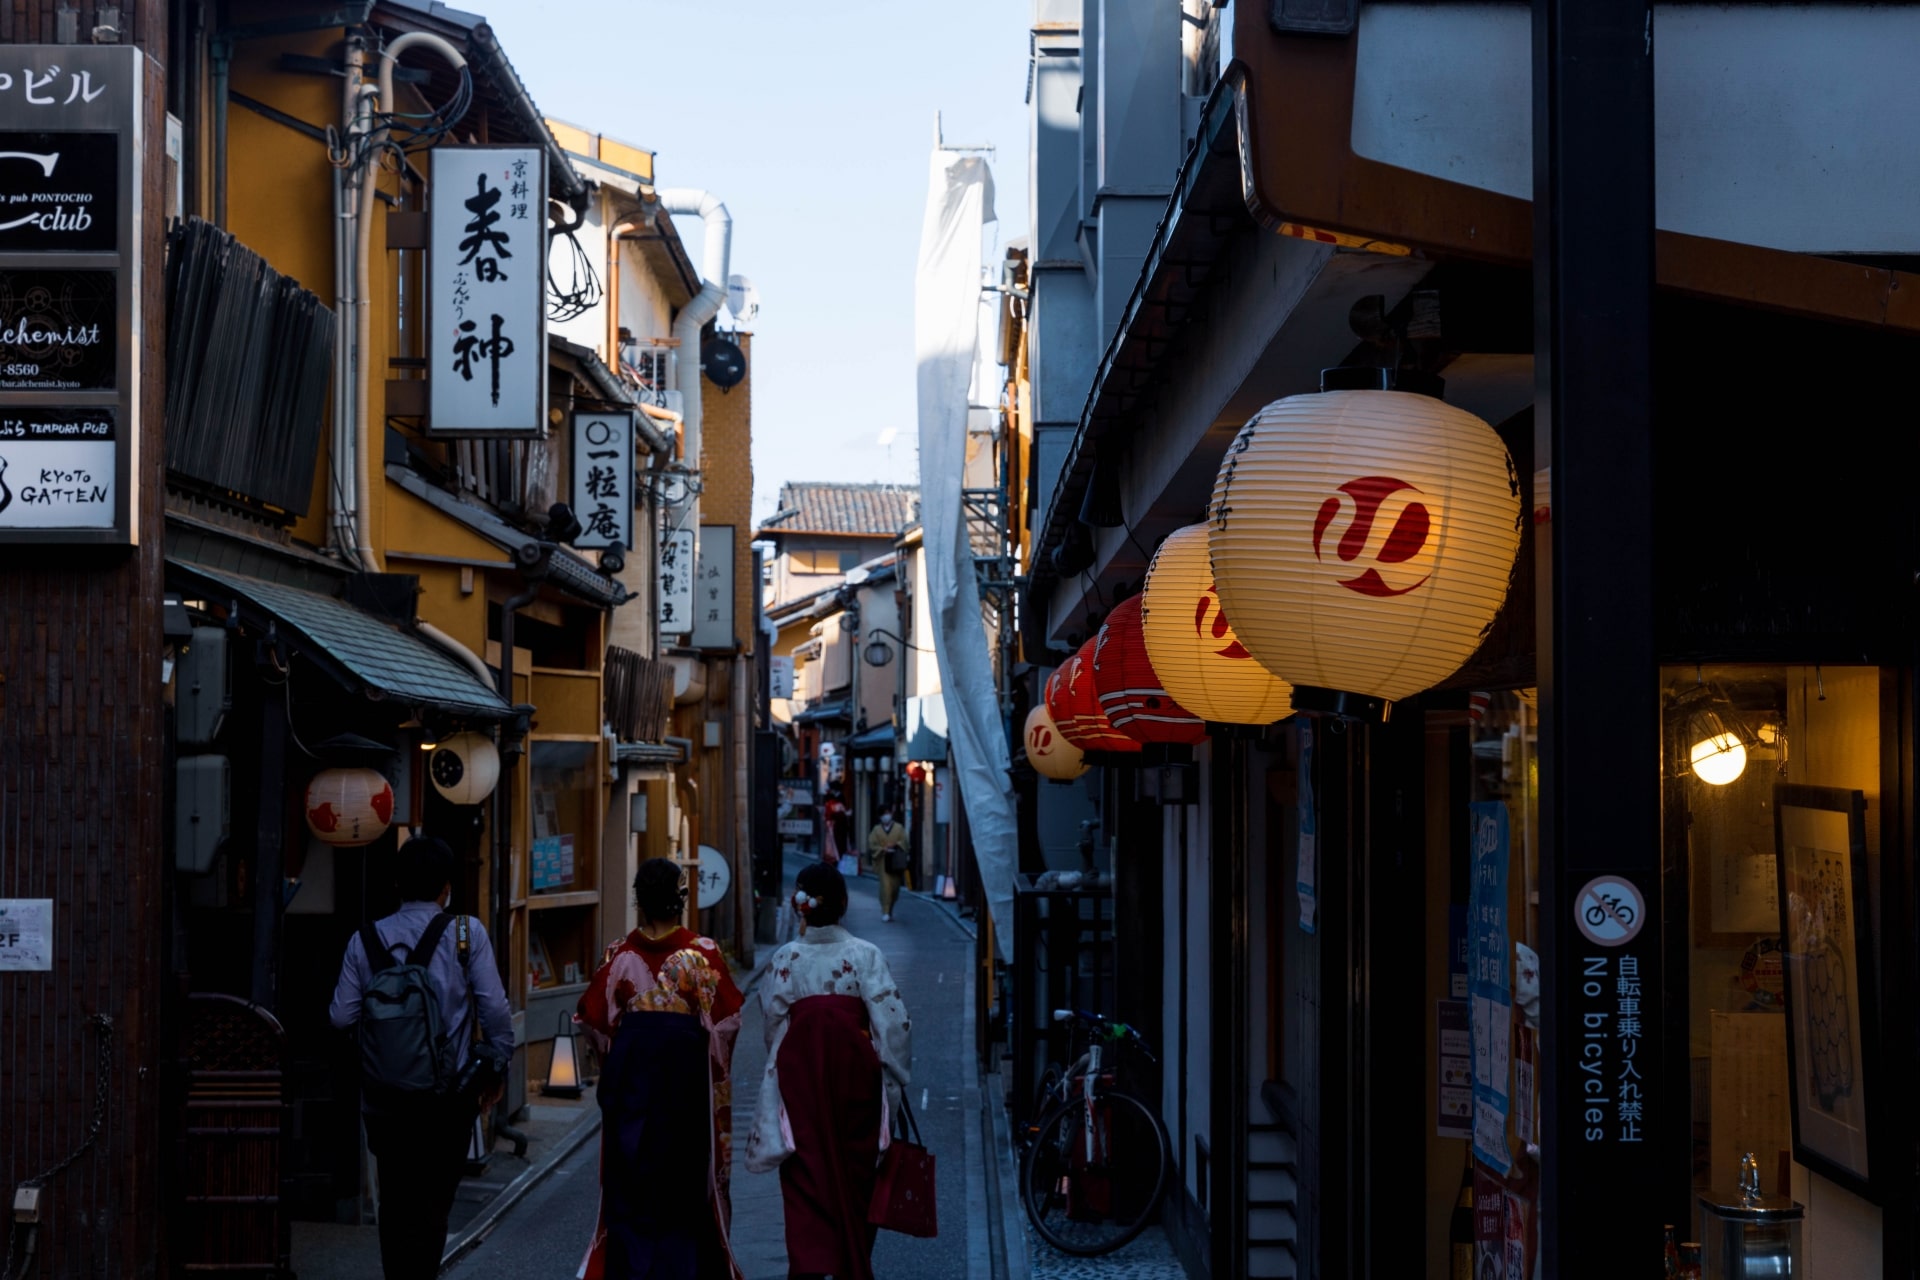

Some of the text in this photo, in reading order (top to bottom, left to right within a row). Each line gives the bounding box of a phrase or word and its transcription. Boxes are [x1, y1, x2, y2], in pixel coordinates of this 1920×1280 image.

[9, 193, 28, 204] pub
[31, 193, 93, 202] PONTOCHO
[511, 159, 529, 219] 京料理
[0, 316, 100, 346] chemist
[0, 363, 39, 376] -8560
[30, 423, 80, 434] TEMPURA
[82, 422, 108, 434] PUB
[20, 482, 109, 506] GATTEN
[585, 450, 620, 540] 一粒庵
[1579, 957, 1610, 1141] No bicycles
[1616, 954, 1643, 1141] 自転車乗り入れ禁止
